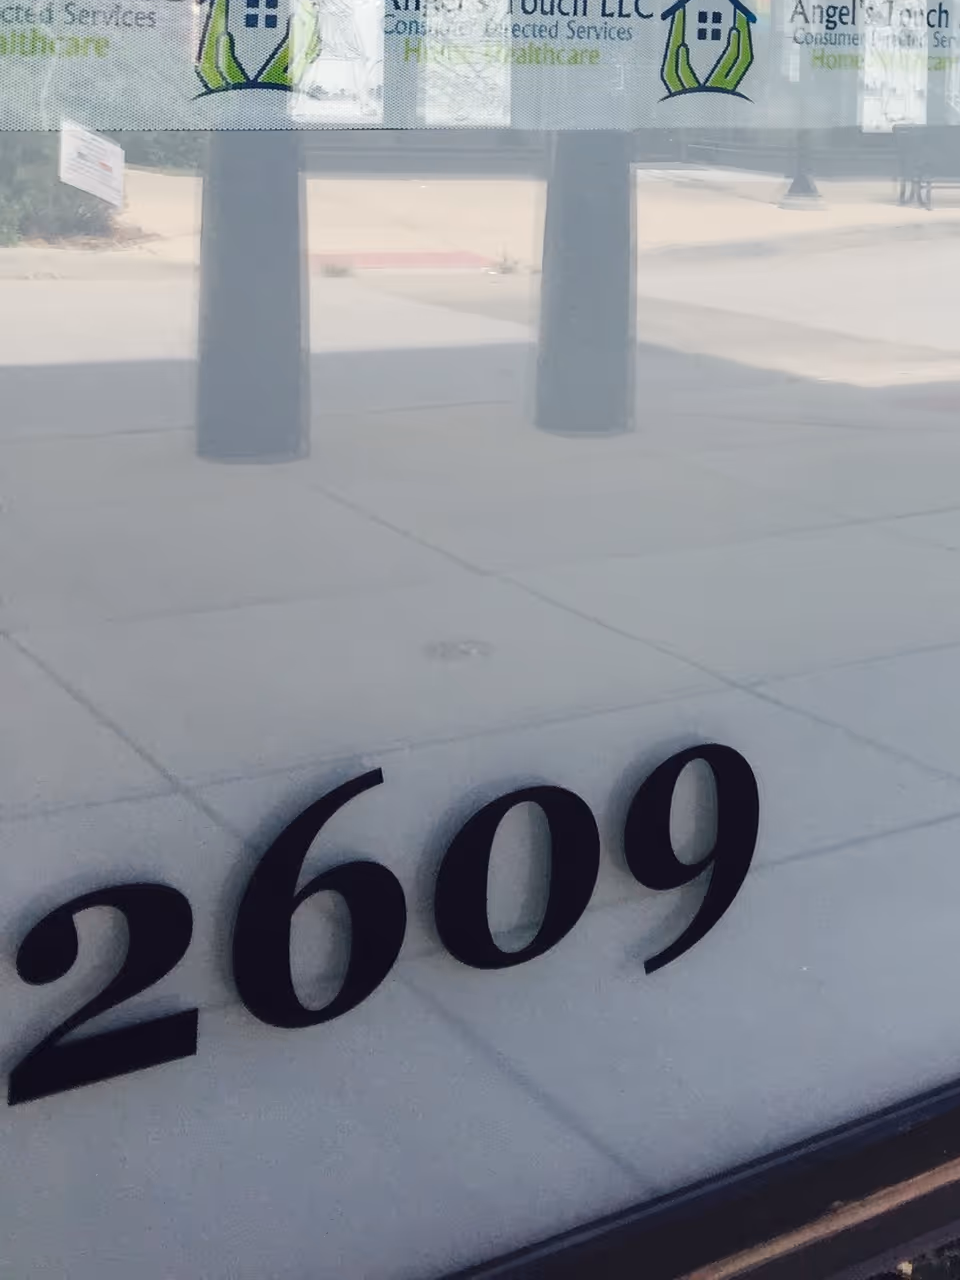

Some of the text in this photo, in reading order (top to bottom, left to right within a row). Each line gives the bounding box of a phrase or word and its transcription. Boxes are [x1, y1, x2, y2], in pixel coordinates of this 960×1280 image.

[64, 2, 157, 28] Services
[882, 0, 949, 29] Touch
[566, 21, 632, 41] Services
[6, 742, 761, 1107] 2609
